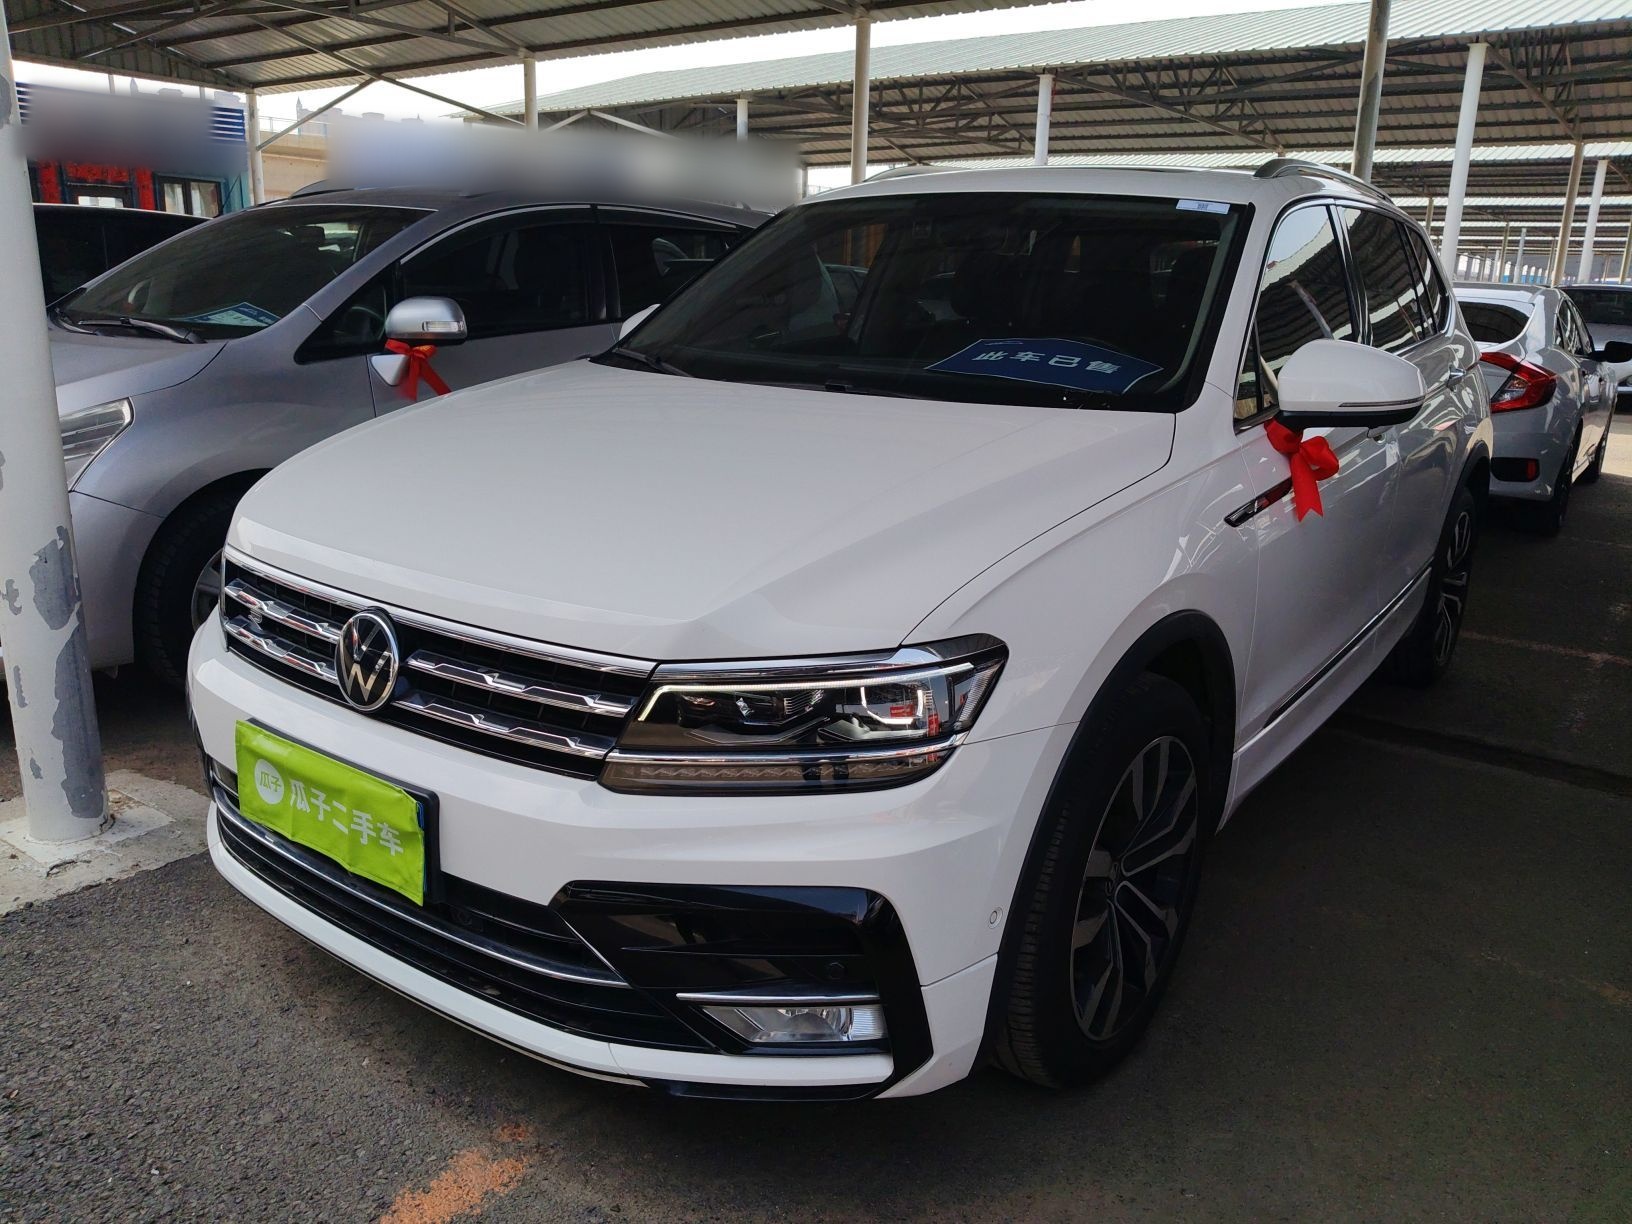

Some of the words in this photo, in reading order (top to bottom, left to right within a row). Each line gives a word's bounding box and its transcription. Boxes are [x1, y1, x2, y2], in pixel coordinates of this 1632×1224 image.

[972, 351, 1121, 374] 此车已售
[258, 771, 282, 793] 瓜子
[288, 779, 404, 857] 瓜子二手车
